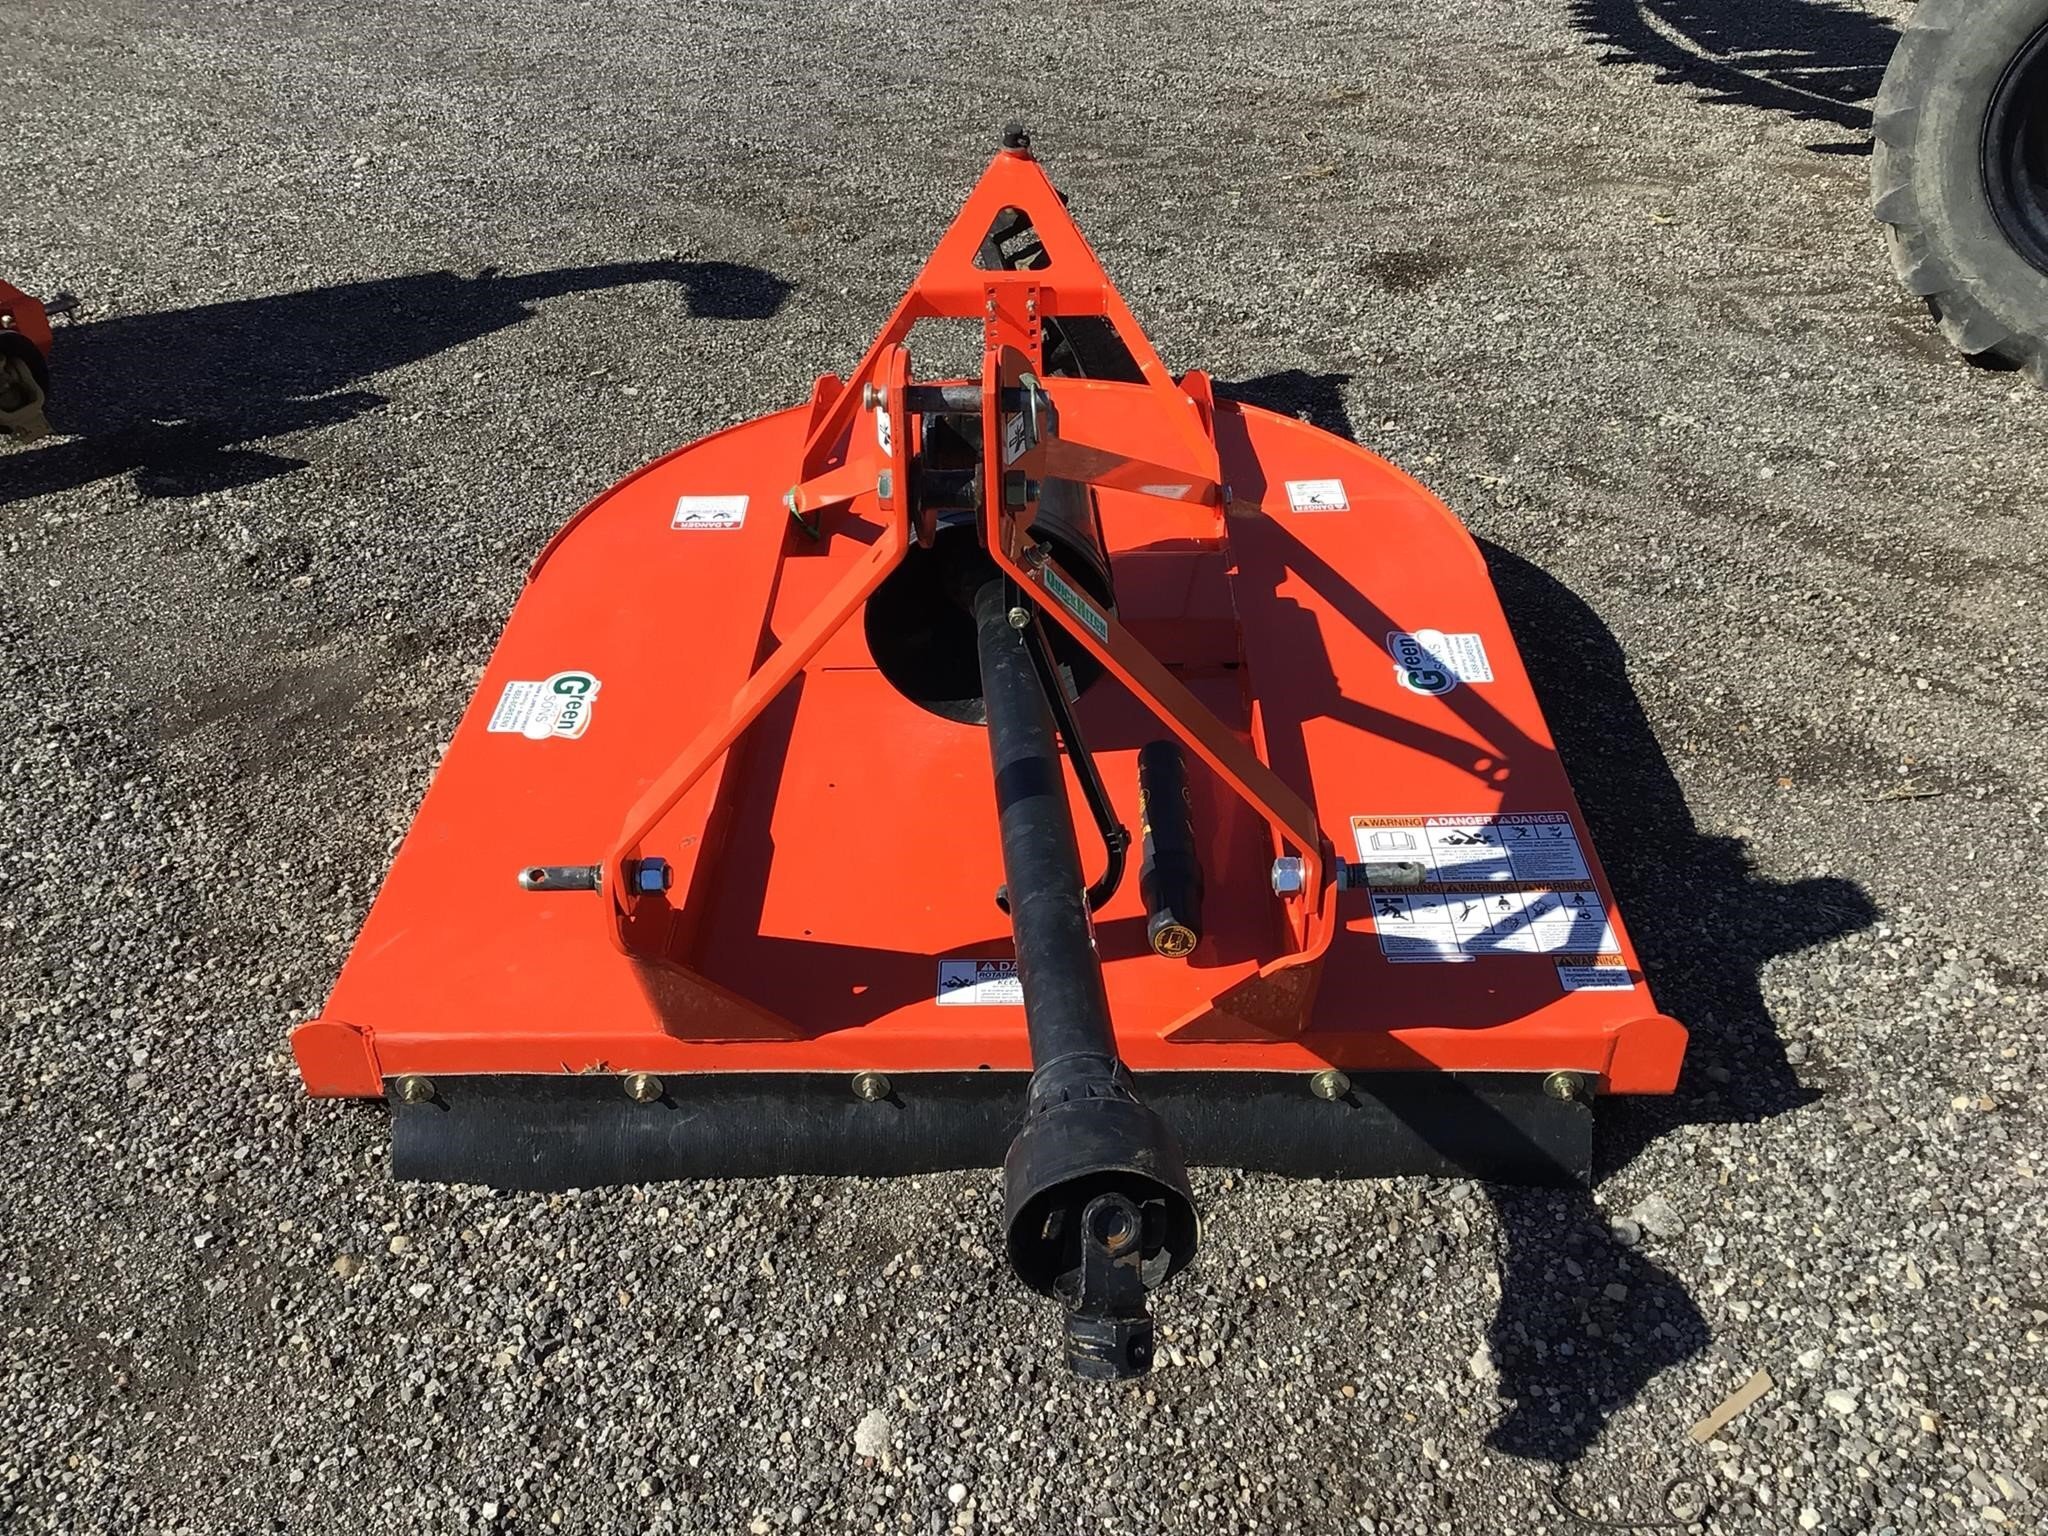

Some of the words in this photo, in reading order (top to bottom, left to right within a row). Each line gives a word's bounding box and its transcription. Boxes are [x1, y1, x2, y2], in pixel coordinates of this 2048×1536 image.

[1429, 643, 1447, 670] SONS
[1399, 638, 1447, 690] Green
[553, 675, 592, 729] Green
[535, 694, 556, 722] SONS
[1369, 818, 1422, 827] WARNING
[1439, 816, 1494, 827] DANGER
[1511, 814, 1566, 824] DANGER
[1388, 884, 1441, 893] WARNING
[1459, 882, 1516, 892] WARNING
[1534, 881, 1592, 891] WARNING
[1573, 956, 1622, 966] WARNING
